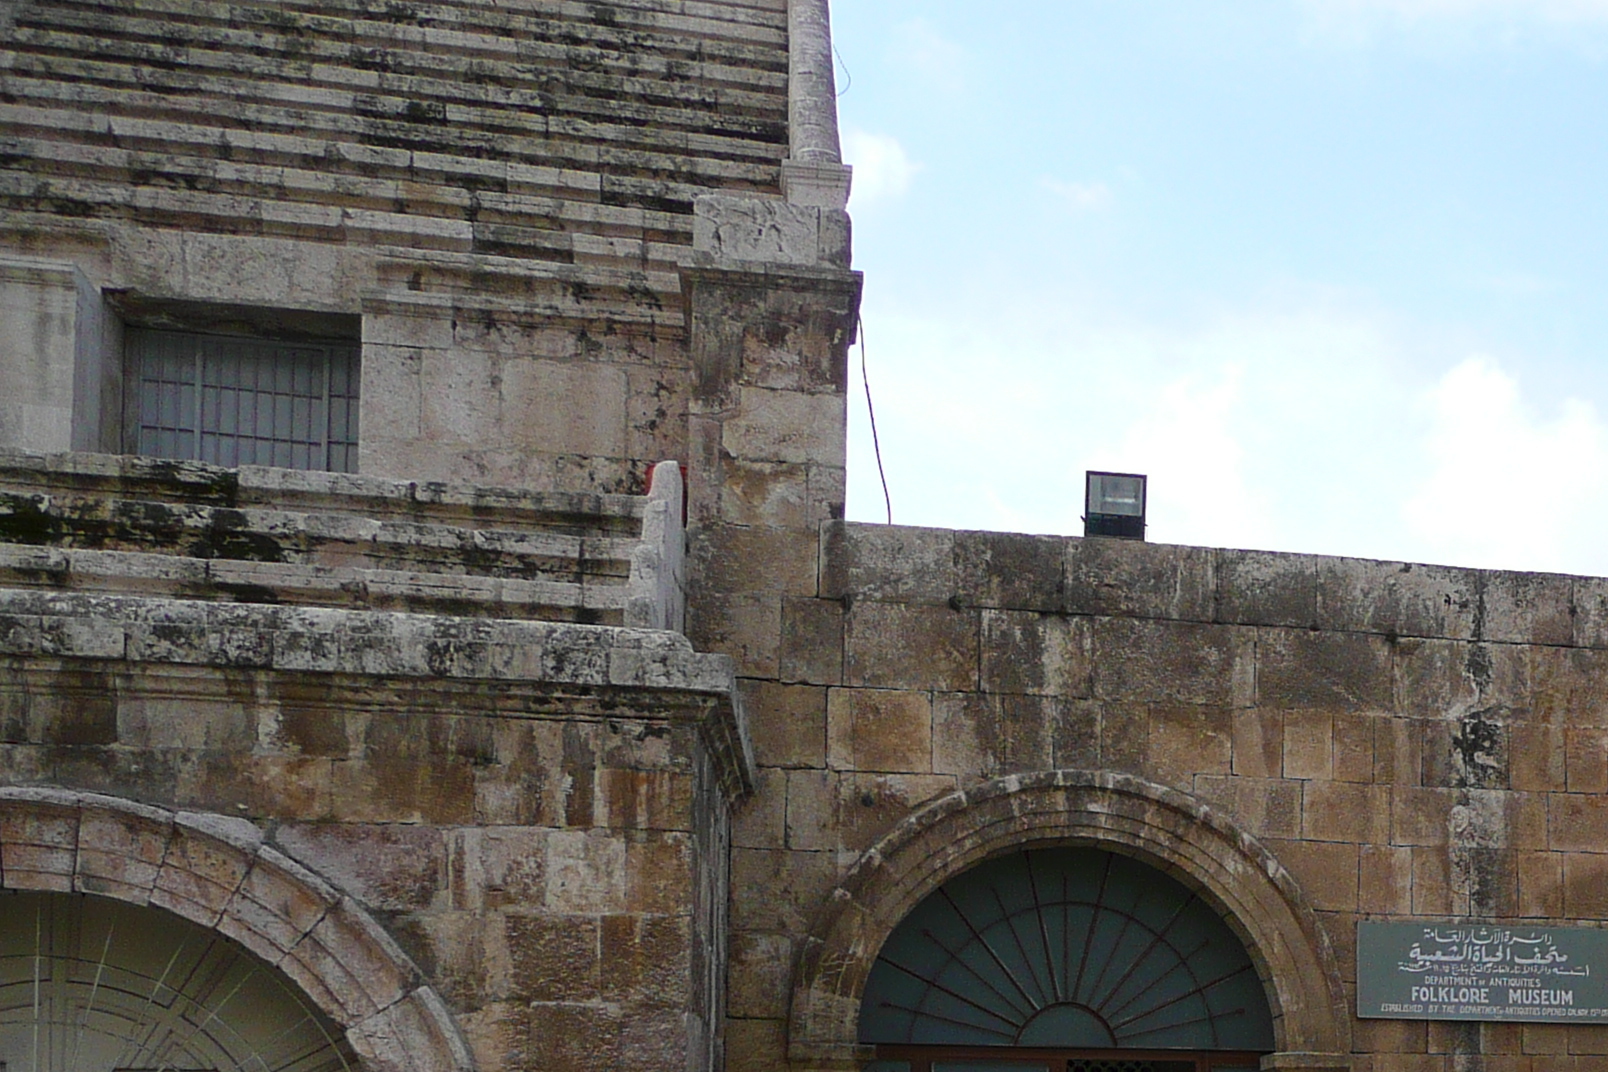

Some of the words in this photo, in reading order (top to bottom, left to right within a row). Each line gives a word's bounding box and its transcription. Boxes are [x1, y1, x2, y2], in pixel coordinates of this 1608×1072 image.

[1423, 928, 1465, 942] العامة
[1504, 930, 1552, 945] دائرة
[1409, 943, 1472, 966] الشعبية
[1473, 944, 1511, 967] الحياة
[1514, 945, 1568, 964] متحف
[1424, 975, 1478, 986] DEPARTMENT
[1489, 977, 1542, 988] ANTIQUITIES
[1411, 986, 1490, 1004] FOLKLORE
[1508, 988, 1573, 1006] MUSEUM
[1381, 1003, 1424, 1013] ESTABLISHED
[1428, 1004, 1439, 1013] BY
[1441, 1004, 1456, 1014] THE
[1459, 1005, 1501, 1015] DEPARTMENT
[1505, 1006, 1541, 1017] ANTIQUITIES
[1541, 1007, 1567, 1017] OPENED
